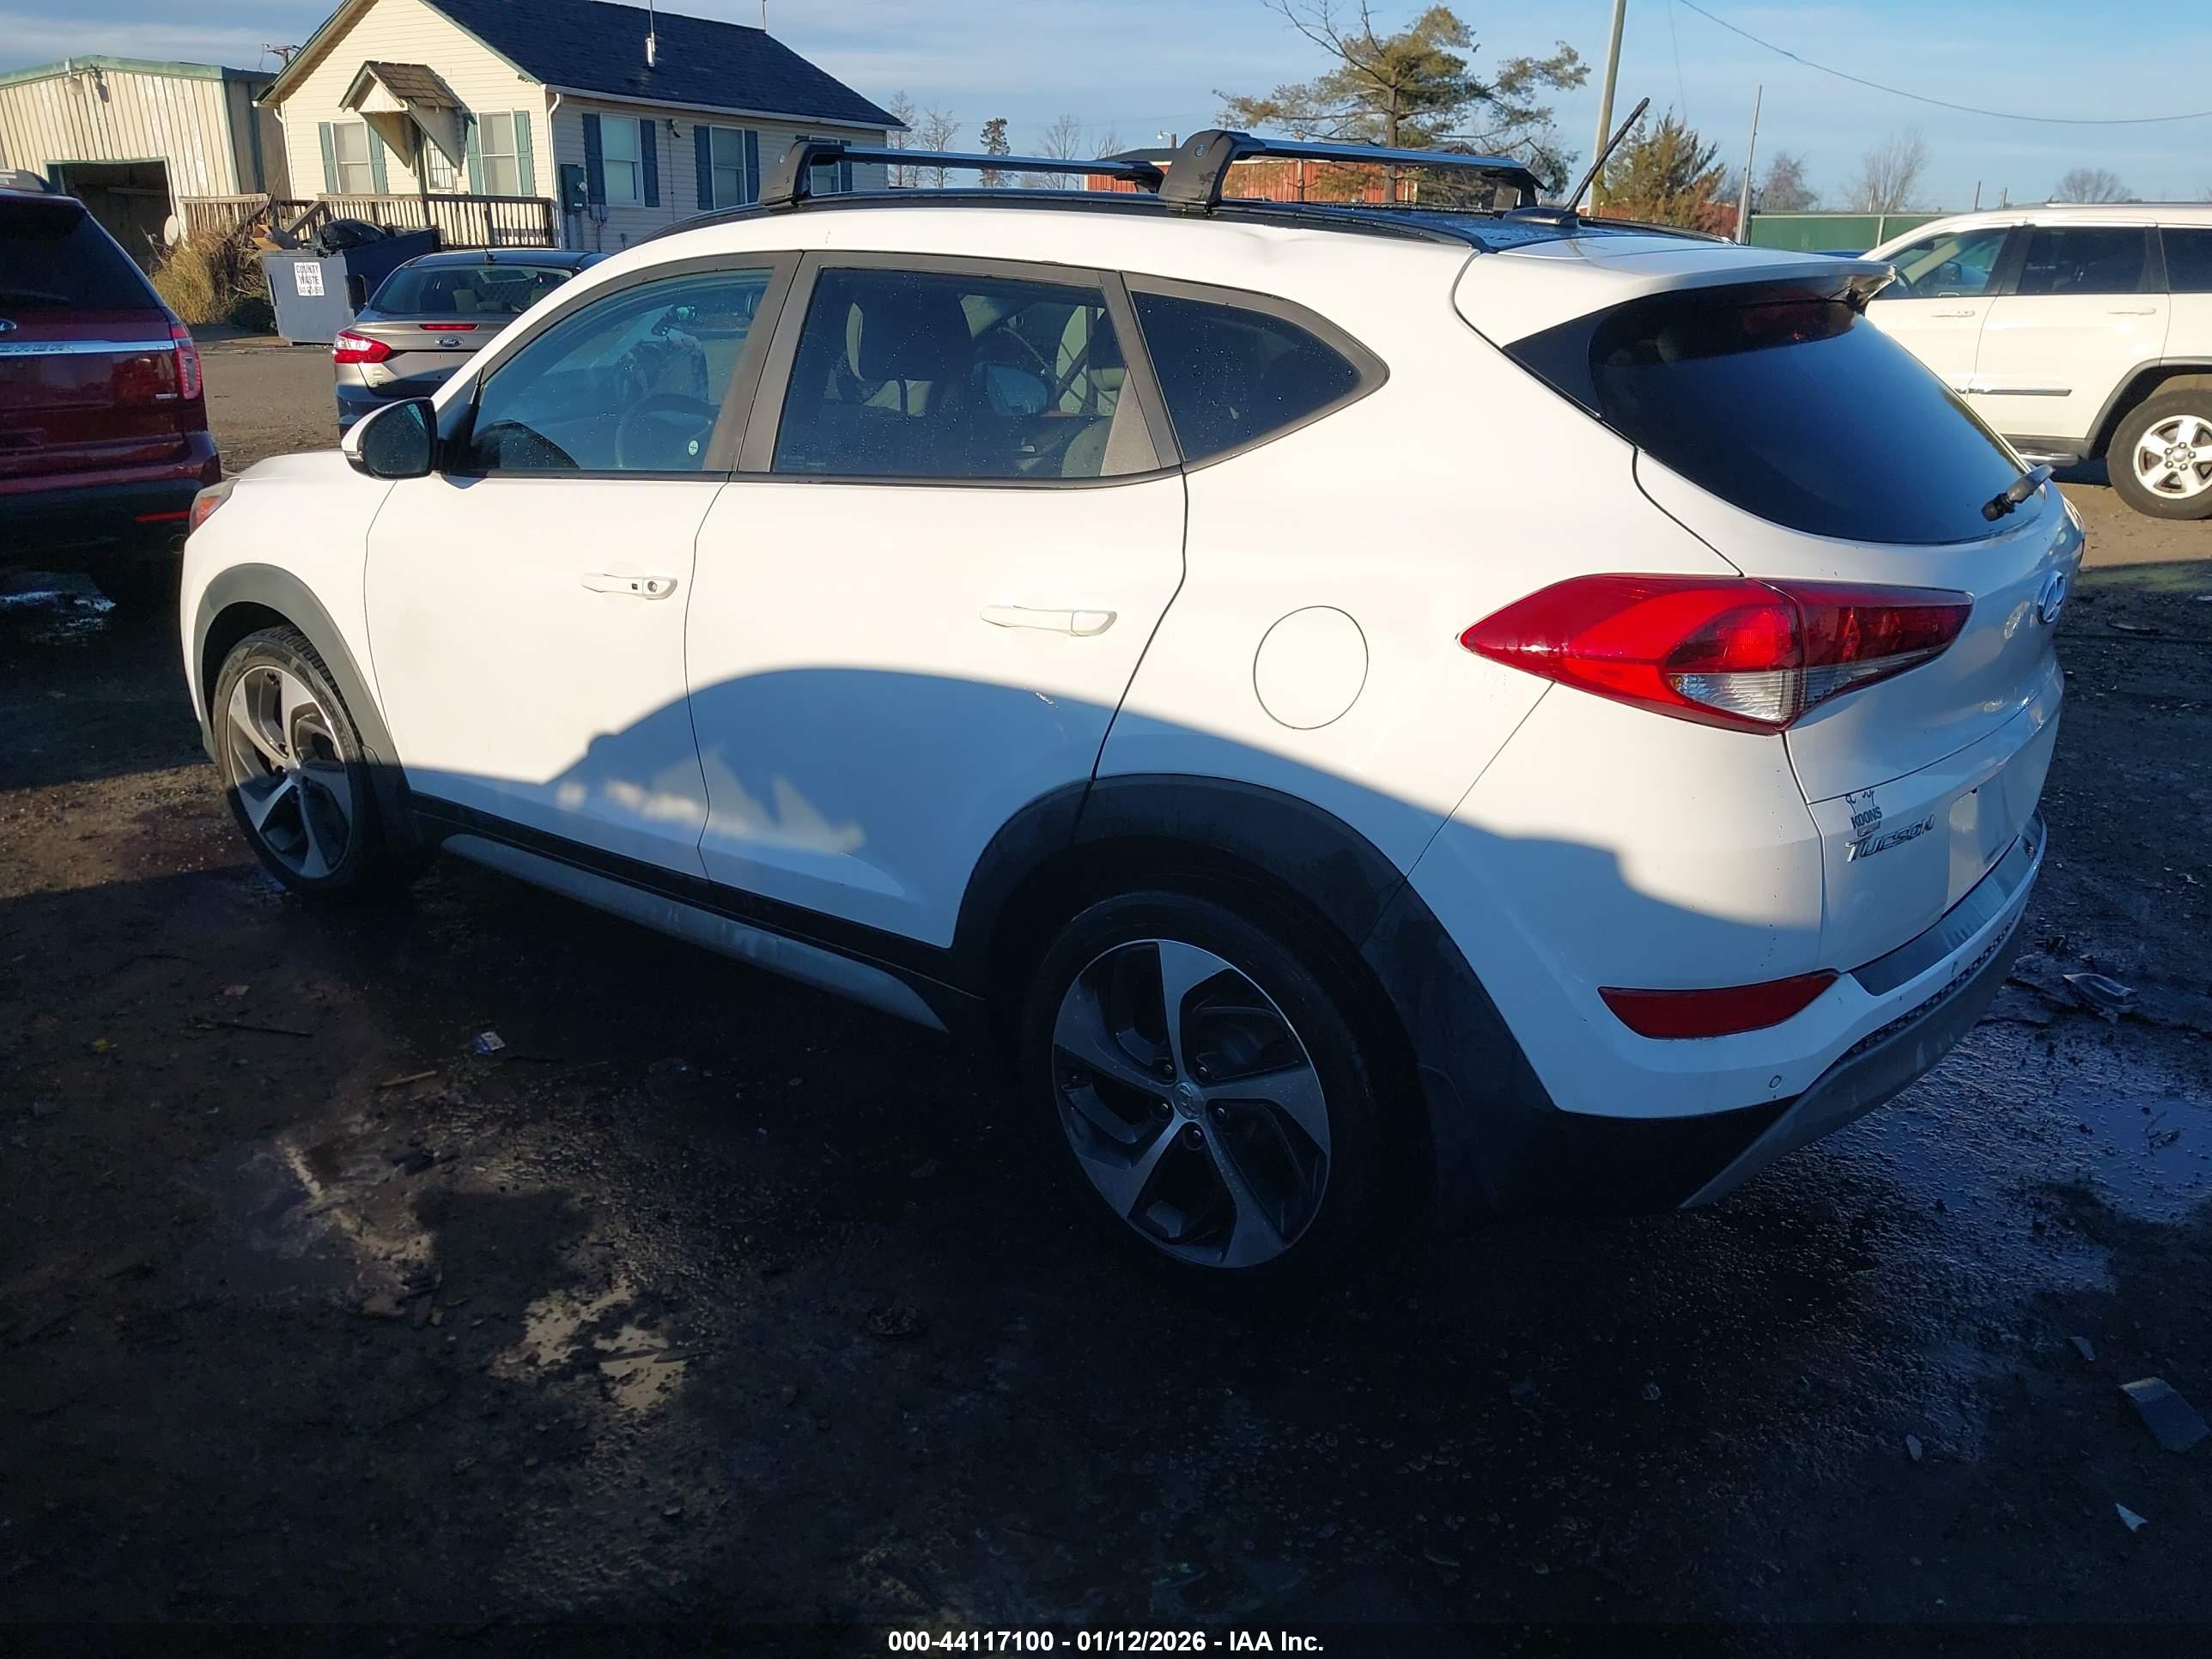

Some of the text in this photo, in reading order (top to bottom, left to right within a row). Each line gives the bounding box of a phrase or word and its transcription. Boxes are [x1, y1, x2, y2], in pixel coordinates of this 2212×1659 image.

[296, 264, 319, 274] COUNTY
[299, 275, 320, 285] WASTE
[1850, 806, 1883, 830] KOONS
